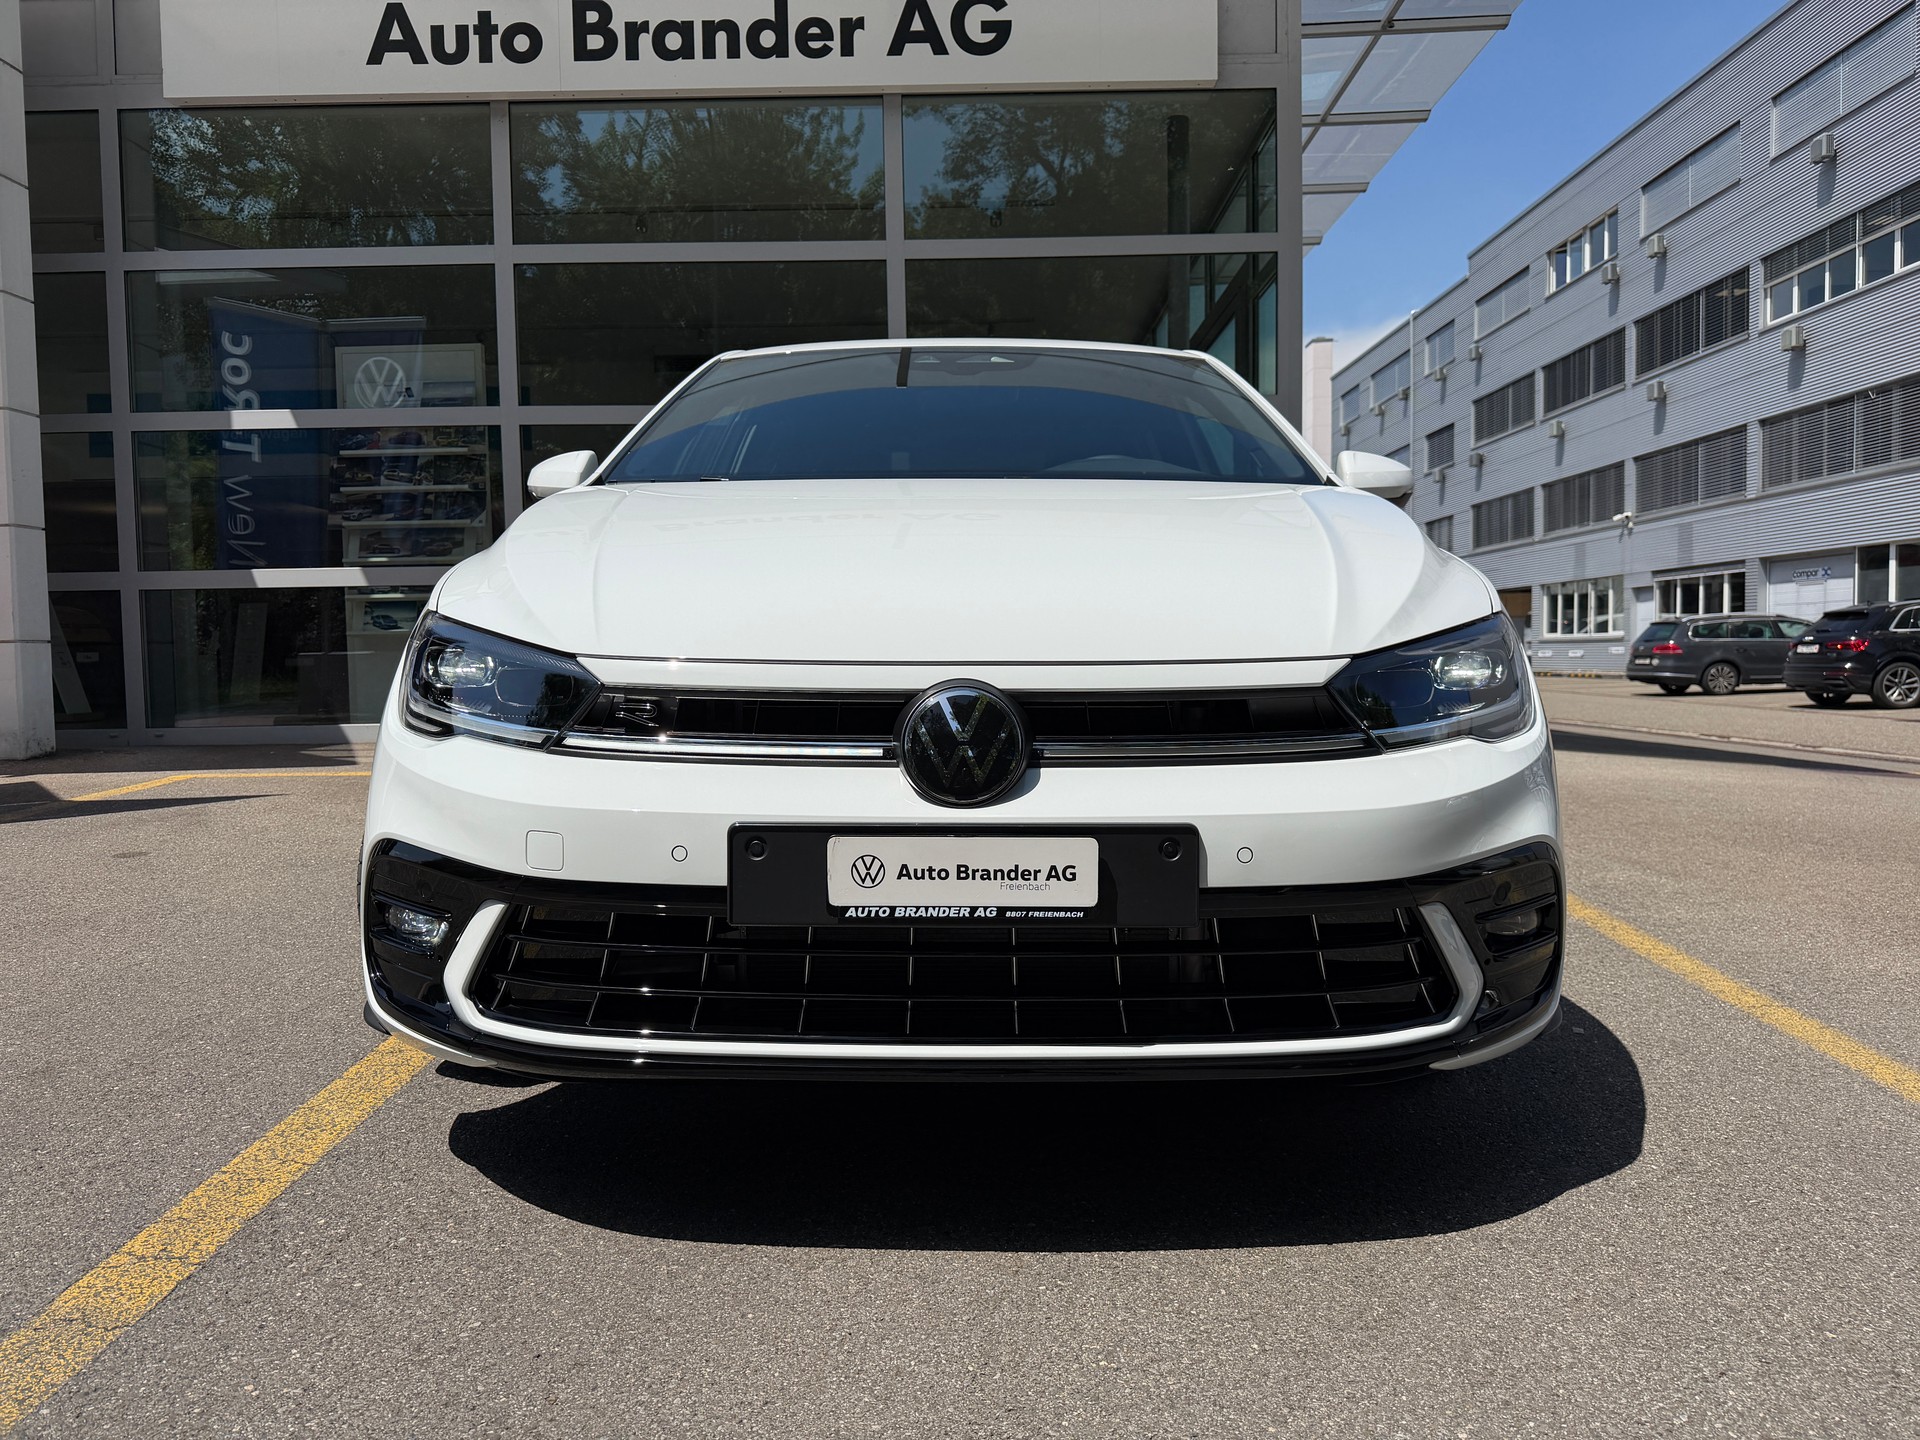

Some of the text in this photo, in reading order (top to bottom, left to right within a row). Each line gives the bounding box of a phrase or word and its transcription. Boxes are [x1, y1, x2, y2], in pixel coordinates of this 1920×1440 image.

[366, 0, 1012, 65] Auto Brander AG
[897, 864, 1077, 882] Auto Brander AG
[1000, 882, 1050, 891] Freienbach
[845, 907, 890, 917] AUTO
[894, 907, 970, 917] BRANDER
[974, 907, 997, 917] AG
